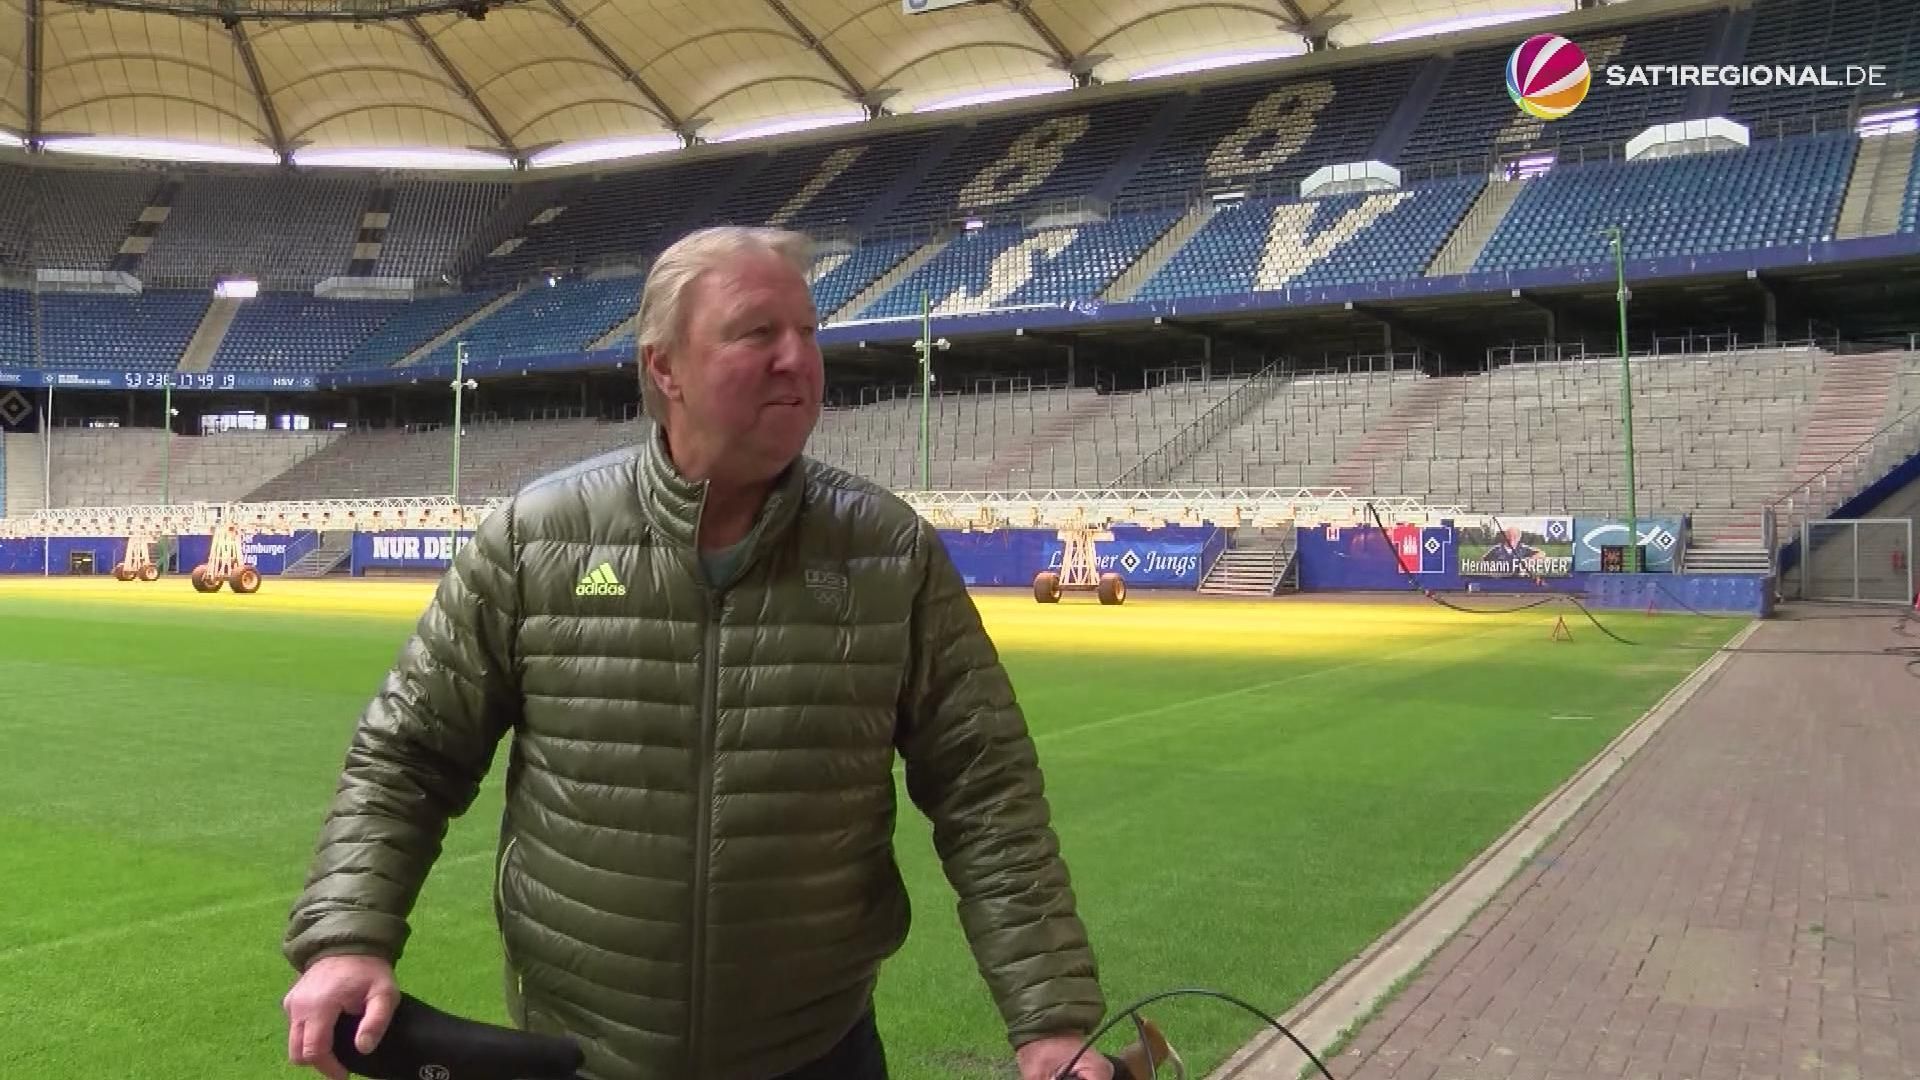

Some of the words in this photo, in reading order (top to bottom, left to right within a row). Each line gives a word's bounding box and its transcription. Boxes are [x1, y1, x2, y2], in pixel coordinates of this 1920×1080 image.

[372, 536, 421, 559] NUR
[1144, 550, 1198, 577] Jungs
[1461, 558, 1510, 572] Hermann
[1512, 558, 1569, 572] FOREVER
[575, 582, 626, 596] adidas
